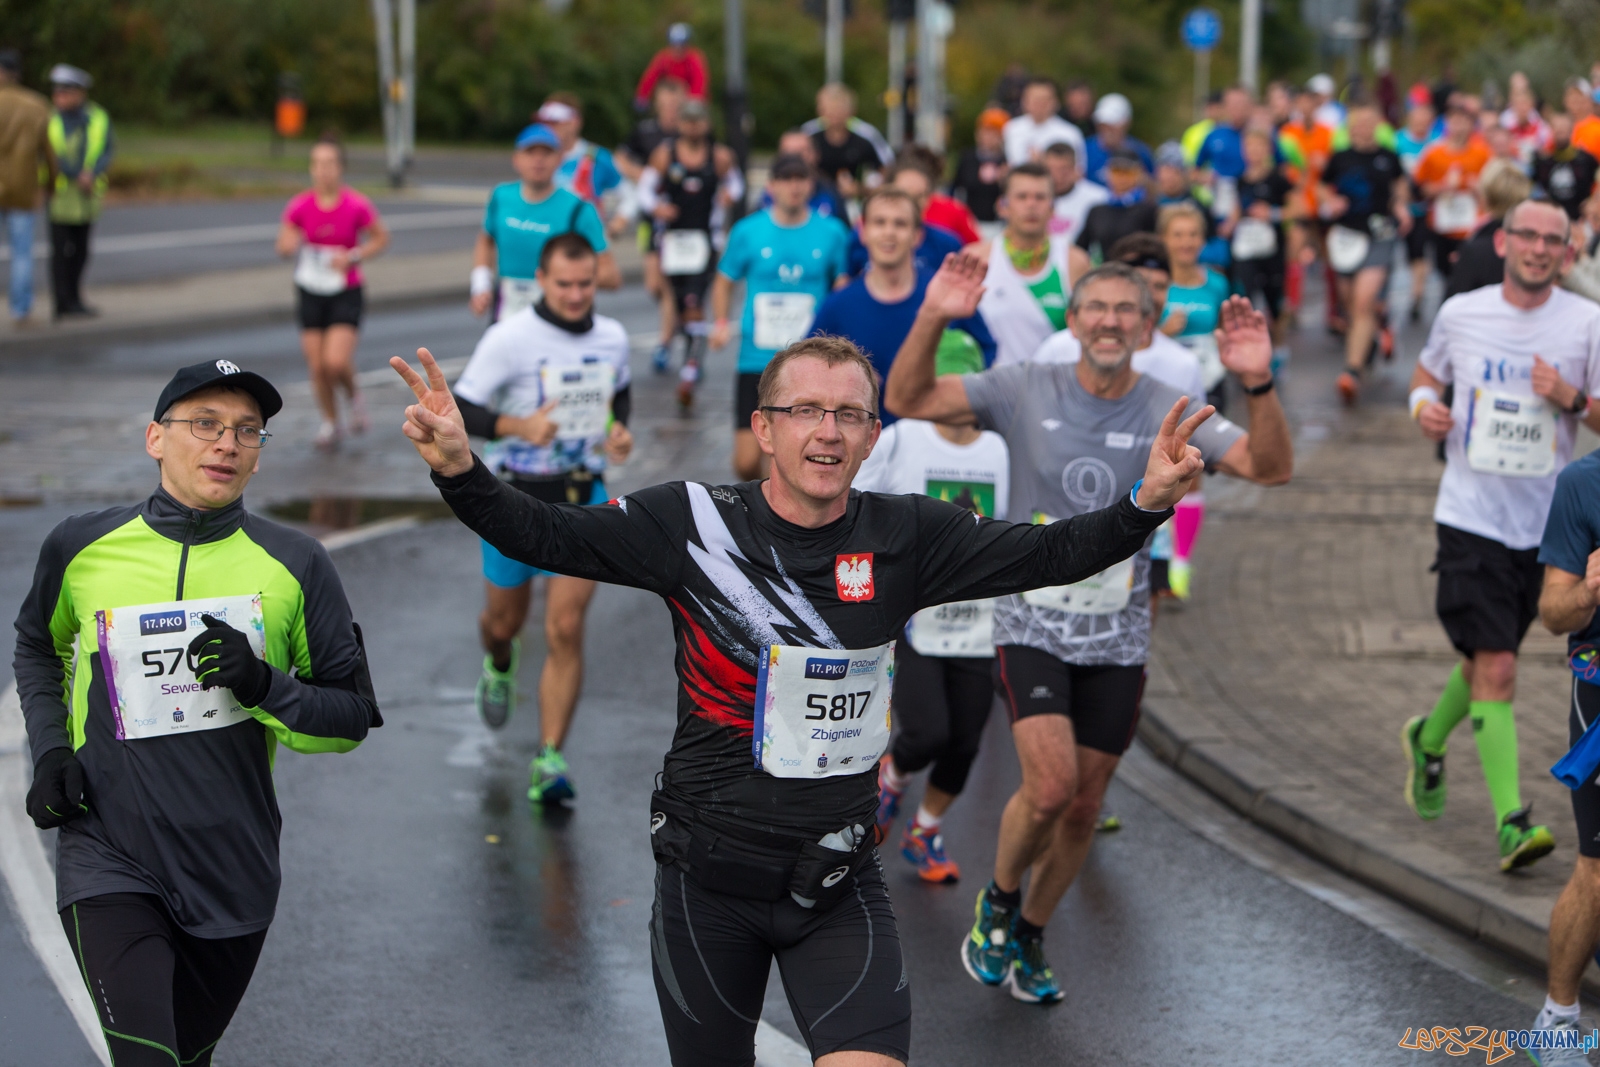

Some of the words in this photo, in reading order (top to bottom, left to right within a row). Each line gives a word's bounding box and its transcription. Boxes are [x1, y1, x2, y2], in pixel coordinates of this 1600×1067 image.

[144, 617, 159, 629] 17.
[160, 616, 183, 629] PKO
[810, 663, 824, 674] 17.
[825, 664, 846, 674] PKO
[849, 666, 877, 675] maraton
[805, 690, 871, 721] 5817
[202, 709, 218, 718] 4F
[811, 728, 862, 743] Zbigniew
[840, 756, 853, 764] 4F
